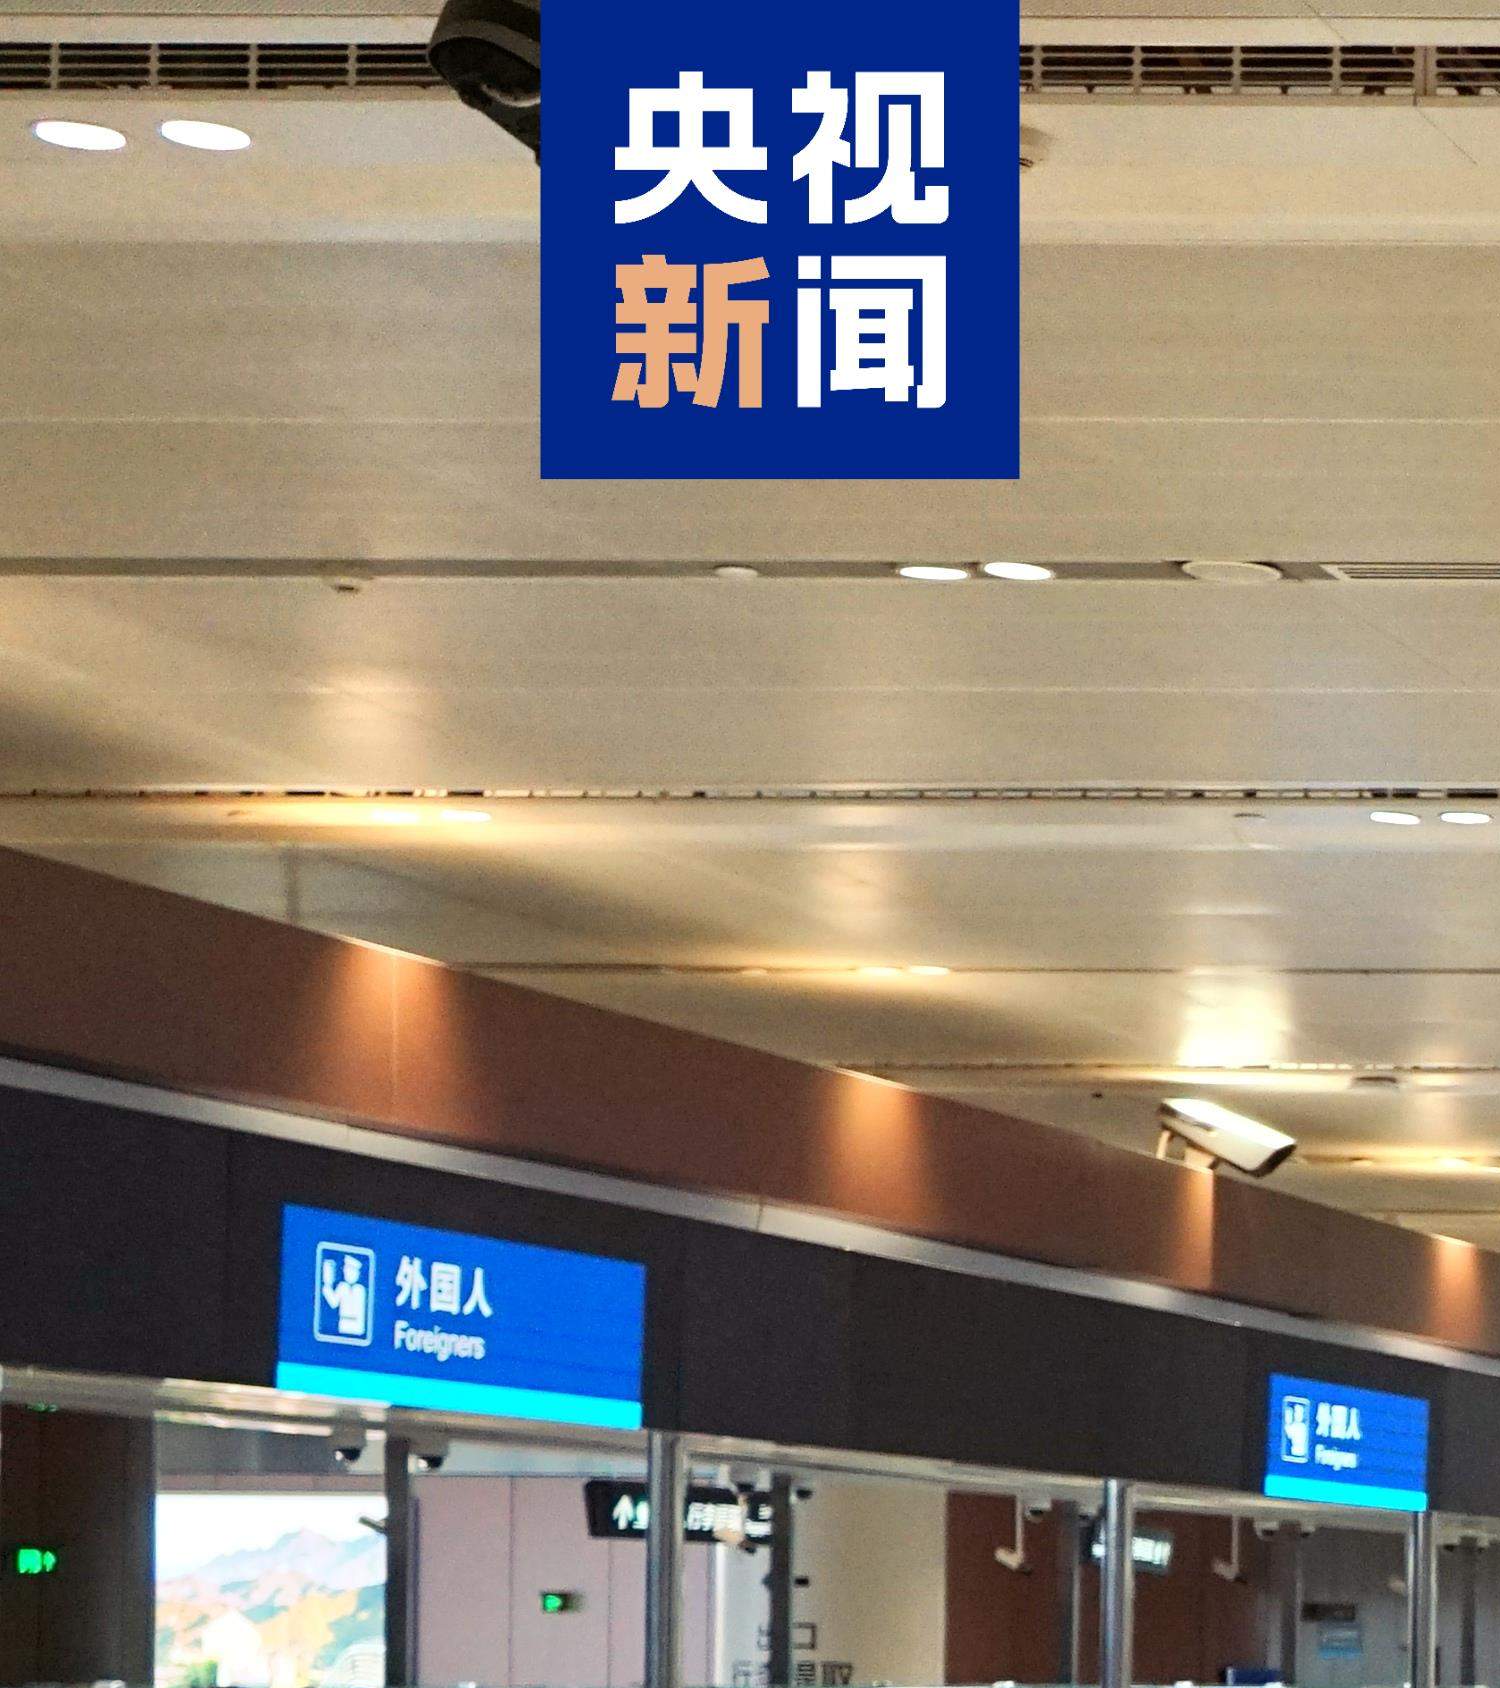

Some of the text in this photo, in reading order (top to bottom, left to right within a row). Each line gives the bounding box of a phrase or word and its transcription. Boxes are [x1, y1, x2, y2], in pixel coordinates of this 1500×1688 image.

[395, 1255, 493, 1318] 外国人
[394, 1320, 486, 1362] Foreigners
[1315, 1402, 1362, 1440] 外国人
